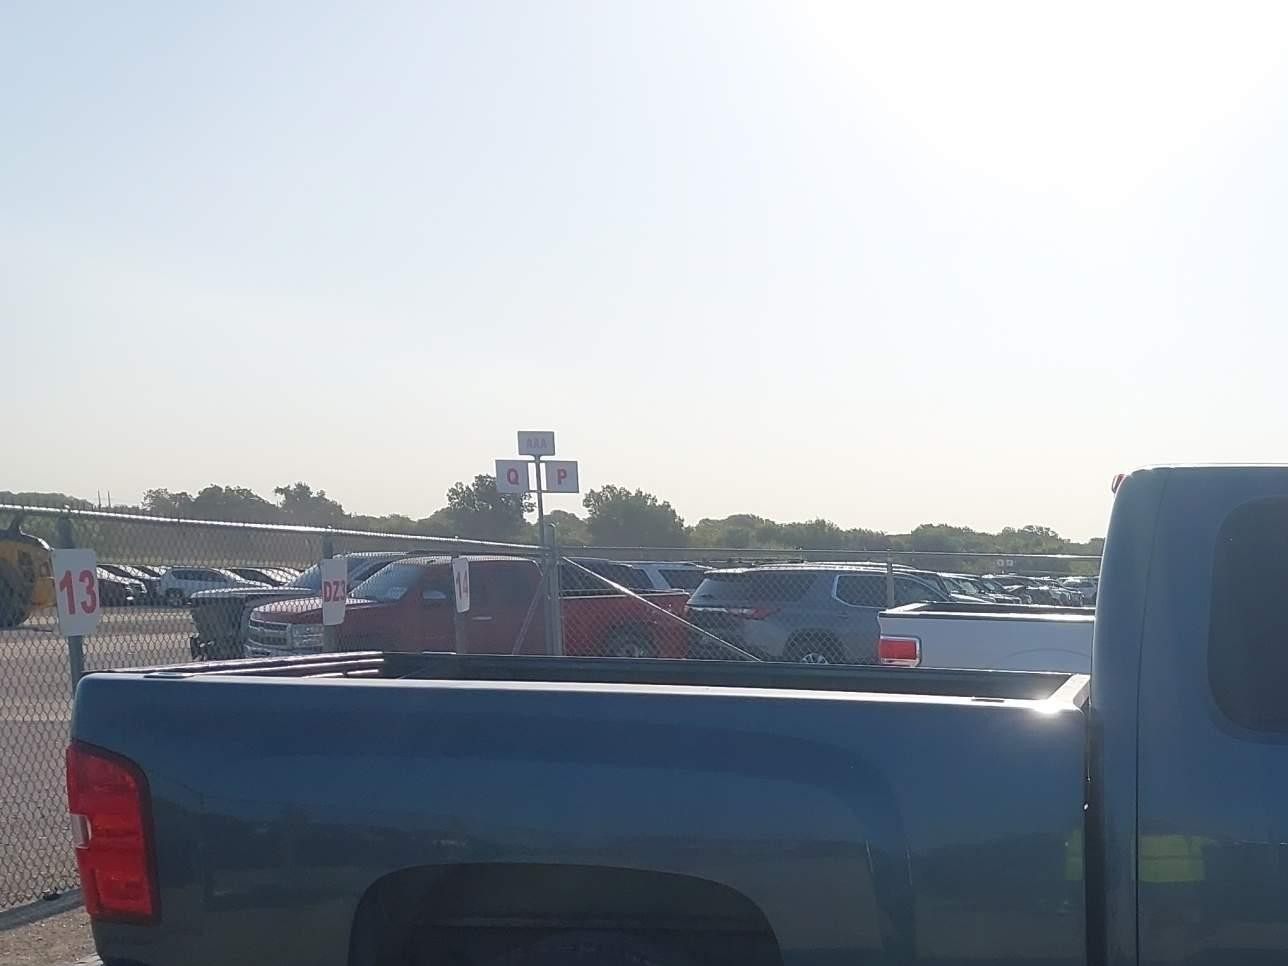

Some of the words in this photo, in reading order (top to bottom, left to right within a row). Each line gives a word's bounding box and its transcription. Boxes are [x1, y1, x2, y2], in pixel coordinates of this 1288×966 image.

[506, 468, 520, 486] Q
[556, 468, 568, 486] P
[59, 569, 97, 615] 13
[456, 570, 469, 600] 14
